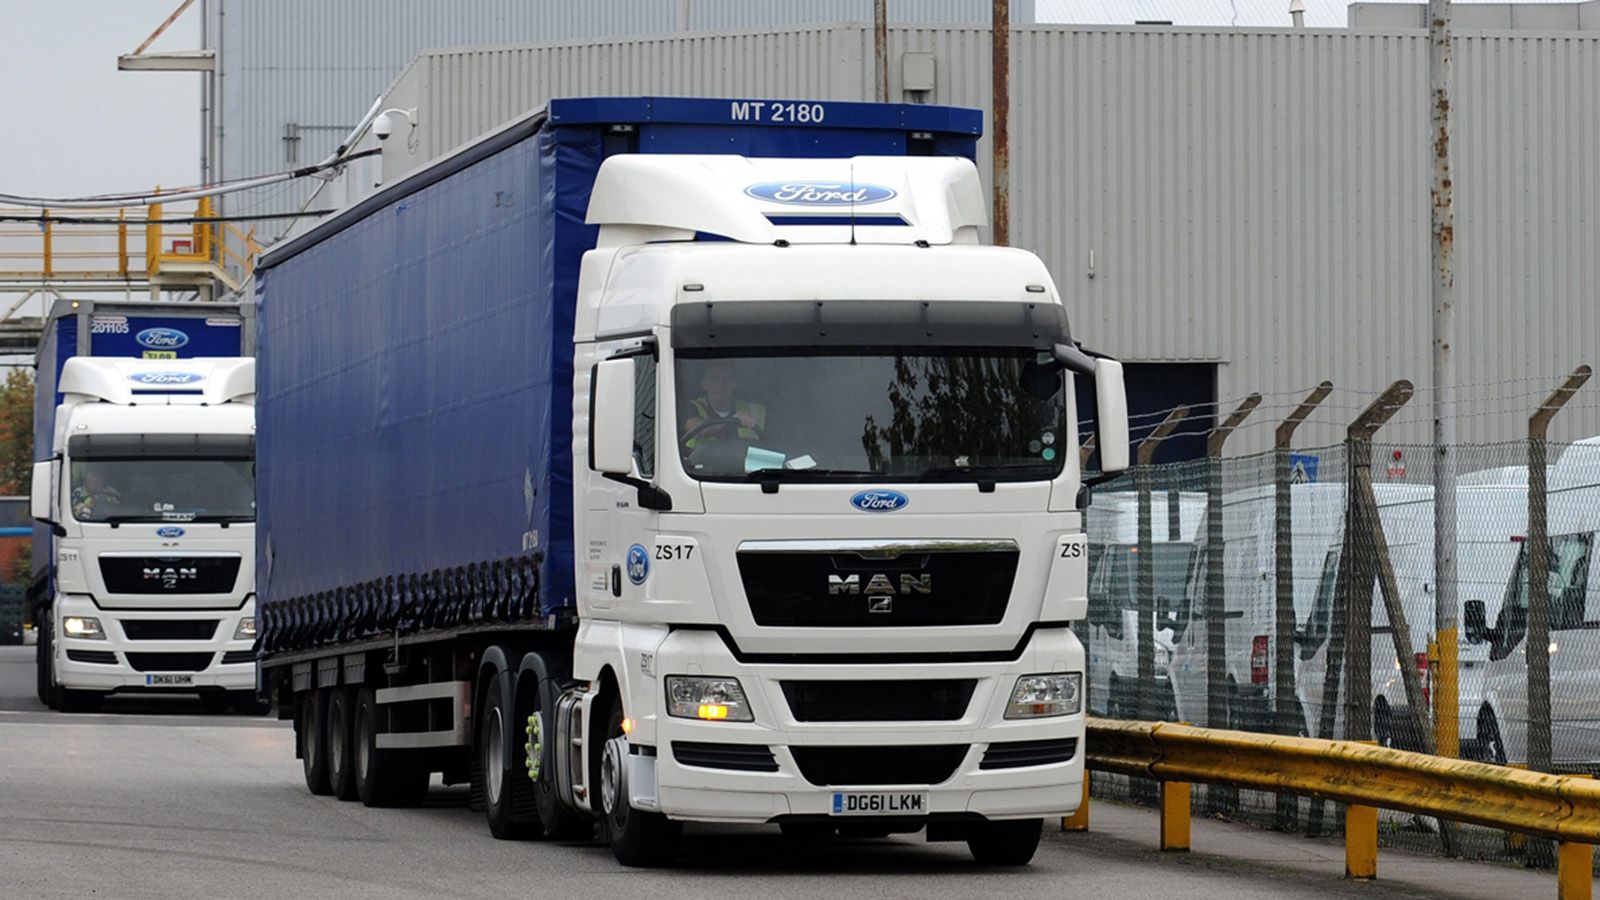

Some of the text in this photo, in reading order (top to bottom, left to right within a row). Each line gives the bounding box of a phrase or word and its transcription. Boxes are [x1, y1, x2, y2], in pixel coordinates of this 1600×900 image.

[731, 102, 824, 123] MT 2180
[774, 184, 868, 201] Ford
[92, 323, 129, 334] 201105
[145, 331, 178, 346] Ford
[141, 372, 192, 383] Ford
[861, 493, 897, 508] Ford
[656, 545, 694, 560] ZS17
[143, 568, 197, 579] MAN
[828, 574, 931, 594] MAN
[847, 794, 922, 811] DG61 LKM
